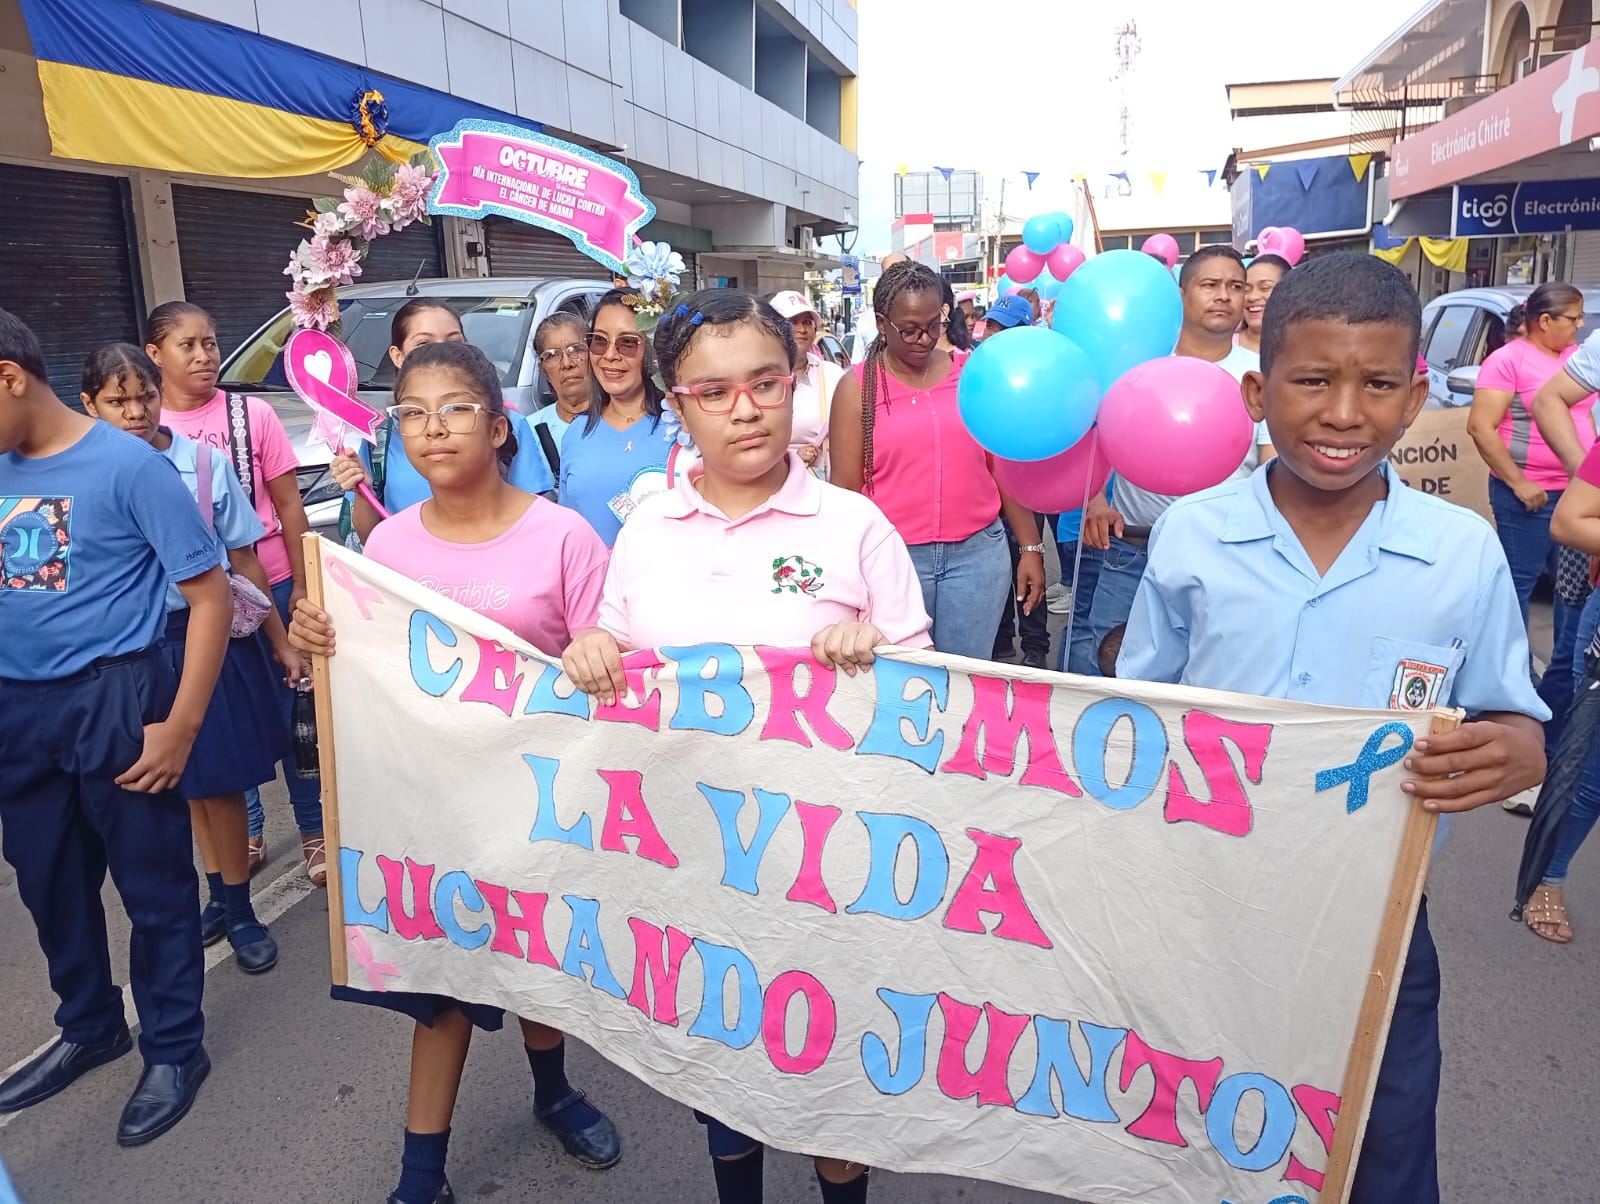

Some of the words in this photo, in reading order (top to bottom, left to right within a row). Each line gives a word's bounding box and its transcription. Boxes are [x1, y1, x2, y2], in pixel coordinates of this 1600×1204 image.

[1431, 127, 1477, 165] Electrónica
[1478, 107, 1511, 146] Chitré
[472, 165, 486, 180] DÍA
[486, 169, 540, 197] INTERNACIONAL
[541, 187, 552, 200] DE
[552, 190, 576, 208] LUCHA
[577, 198, 606, 217] CONTRA
[499, 145, 590, 190] OCTUBRE
[499, 186, 508, 199] EL
[538, 198, 549, 212] DE
[549, 201, 575, 220] MAMA
[230, 393, 247, 438] ACOBS
[1387, 436, 1458, 466] NCIÓN
[1421, 476, 1452, 495] DE
[409, 609, 1273, 837] CELEBREMOS
[522, 753, 680, 869] LA
[696, 781, 1054, 949] VIDA
[340, 846, 838, 1075] LUCHANDO
[860, 987, 1344, 1192] JUNTOS
